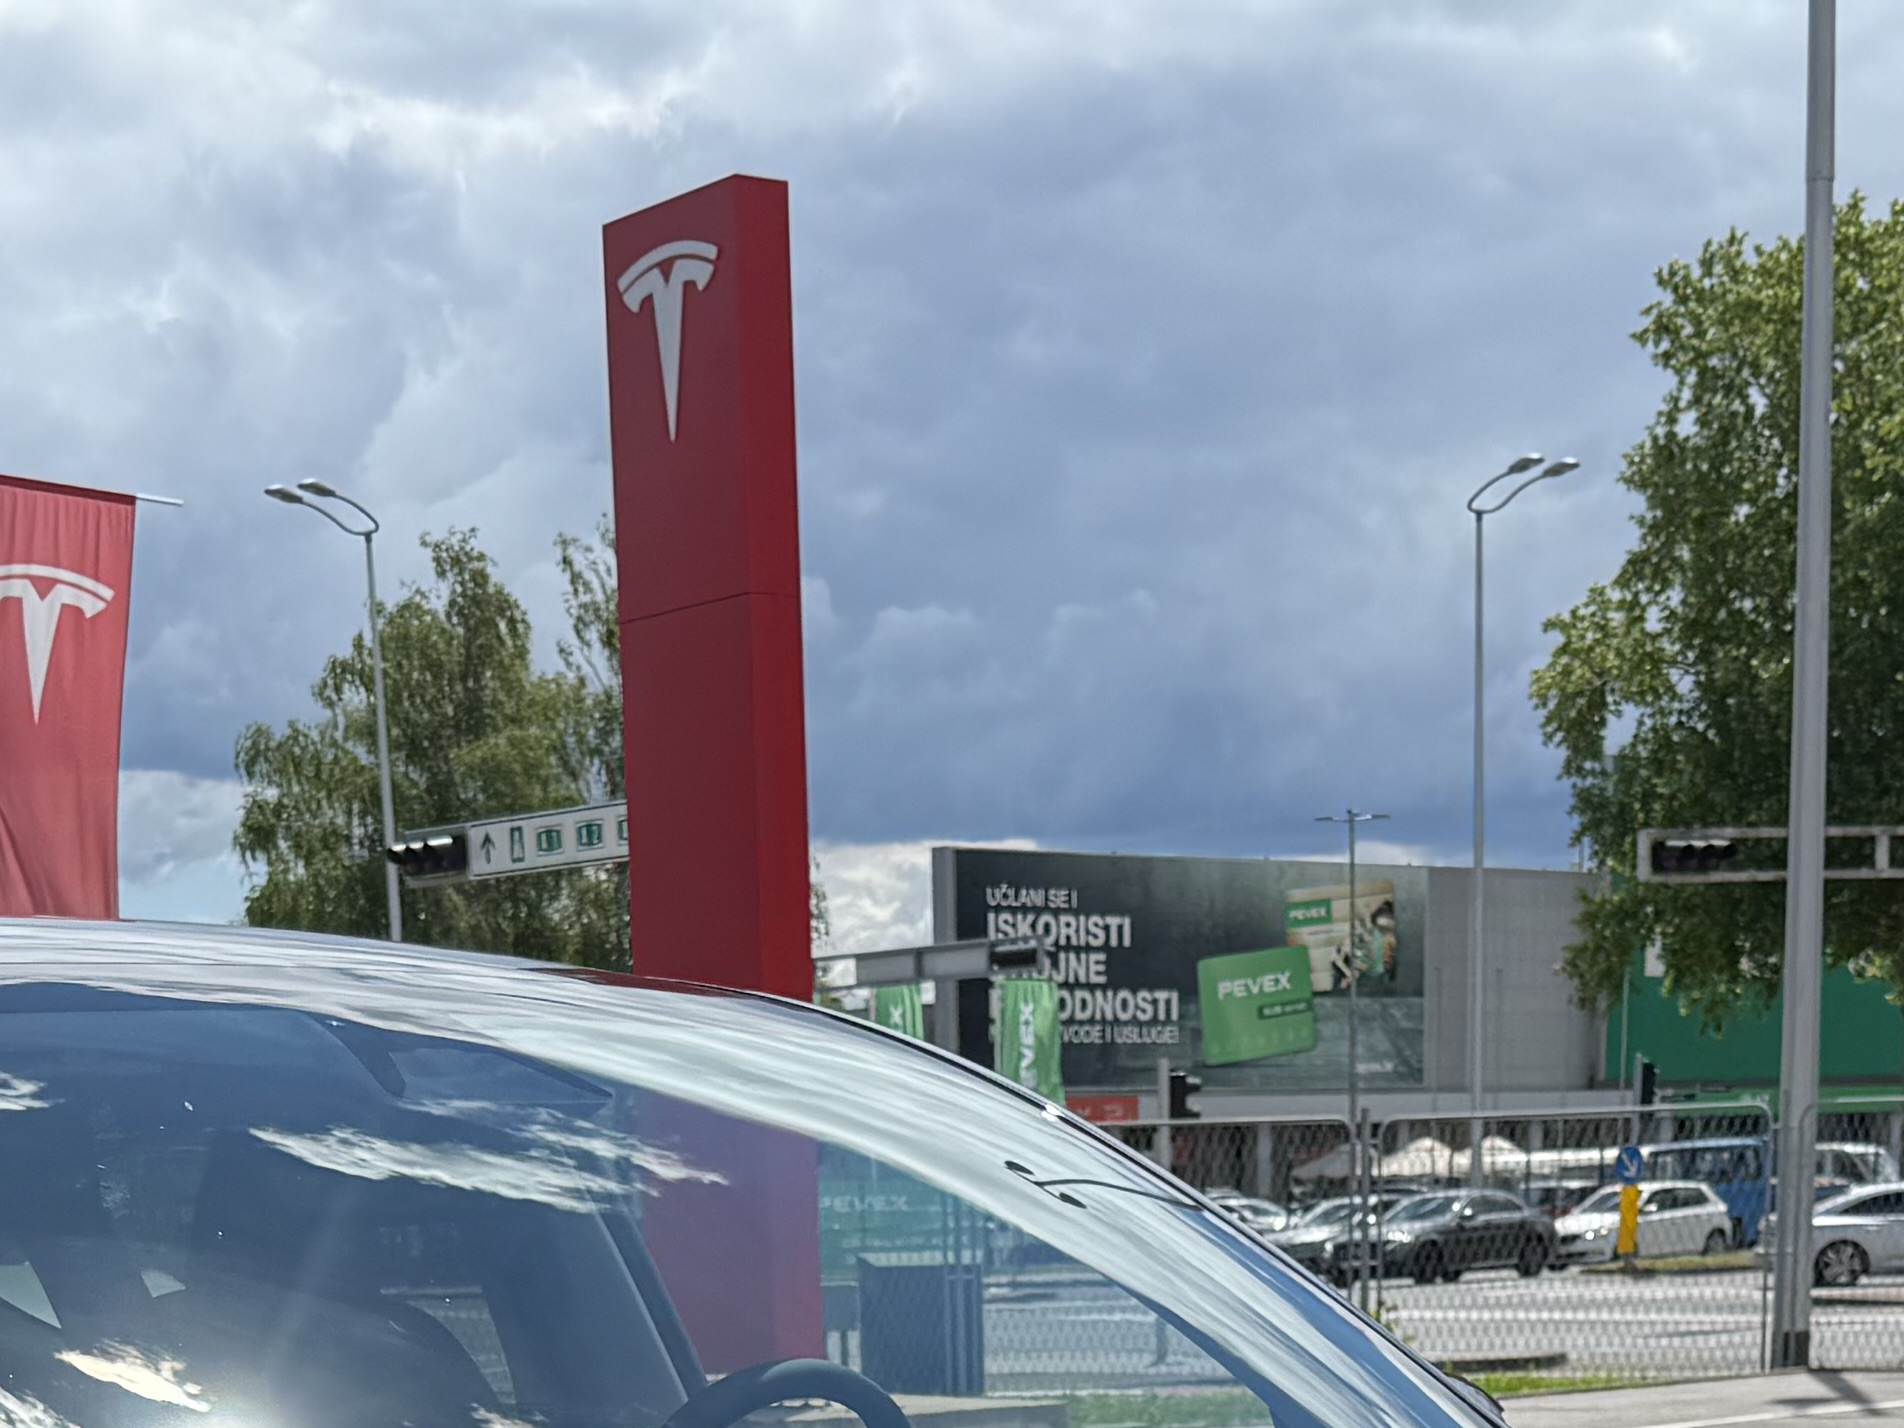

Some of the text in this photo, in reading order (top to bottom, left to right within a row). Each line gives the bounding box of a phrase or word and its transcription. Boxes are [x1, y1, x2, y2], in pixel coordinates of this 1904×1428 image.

[986, 883, 1045, 907] UČLANI
[1047, 888, 1070, 908] SE
[987, 912, 1132, 948] ISKORISTI
[1217, 970, 1291, 1000] PEVEX
